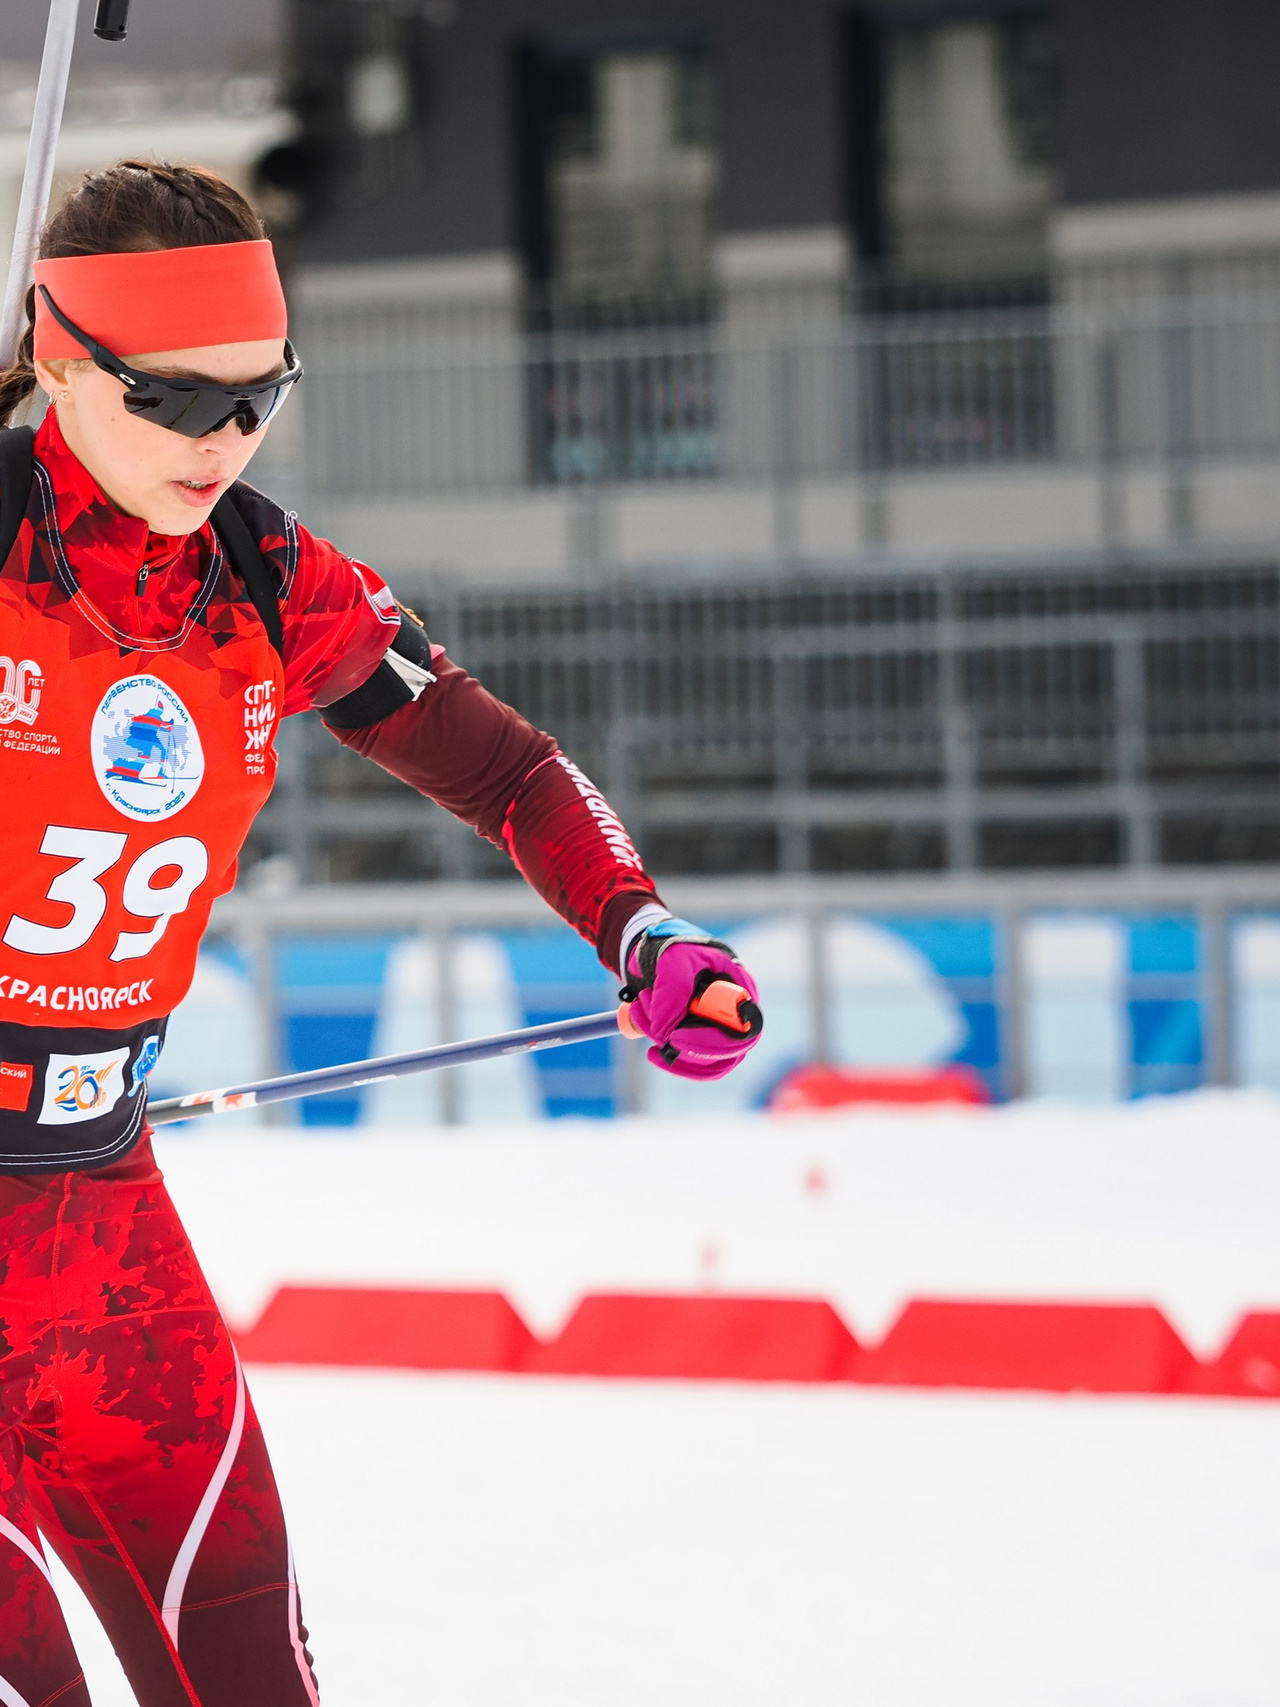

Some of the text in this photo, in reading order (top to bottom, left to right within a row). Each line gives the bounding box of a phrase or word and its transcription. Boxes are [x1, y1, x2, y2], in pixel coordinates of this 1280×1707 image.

[27, 678, 45, 687] ЛЕТ
[101, 678, 188, 723] ПЕРВЕНСТВО РОССИИ
[3, 740, 61, 755] ФЕДЕРАЦИИ
[23, 731, 57, 744] СПОРТА
[111, 789, 161, 816] Красноярск
[165, 790, 186, 811] 2023
[1, 824, 209, 963] 39
